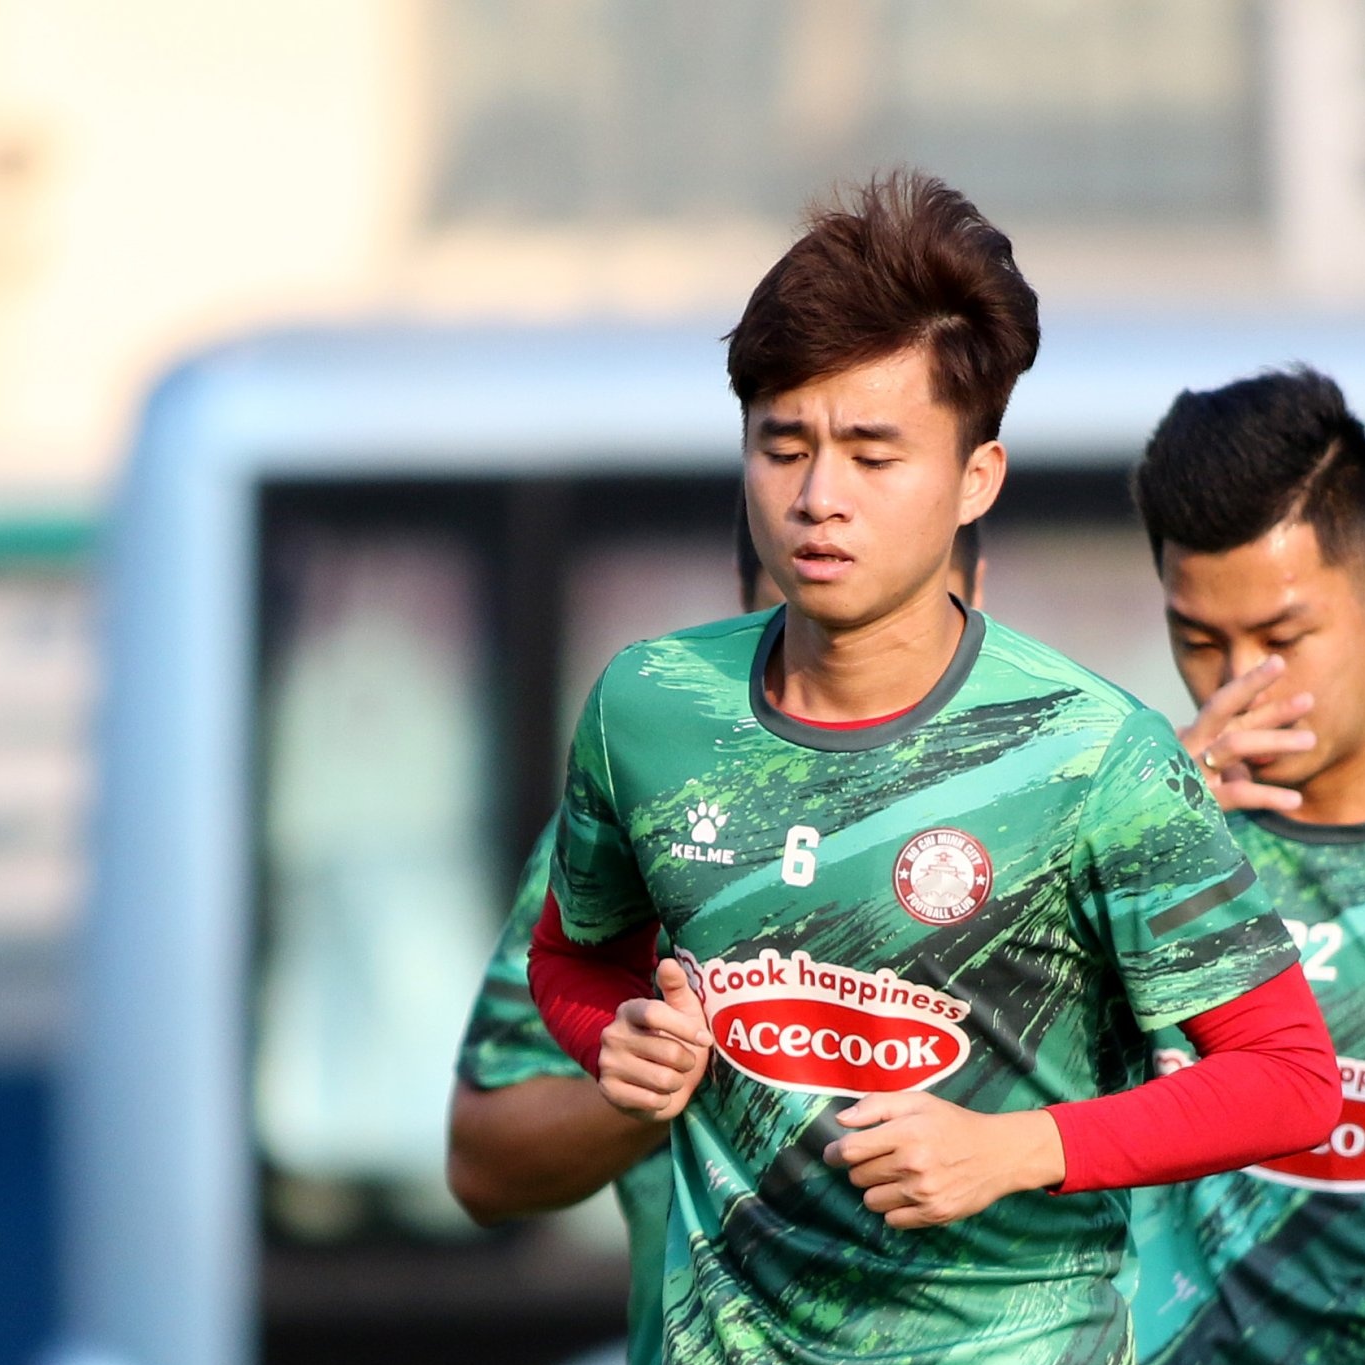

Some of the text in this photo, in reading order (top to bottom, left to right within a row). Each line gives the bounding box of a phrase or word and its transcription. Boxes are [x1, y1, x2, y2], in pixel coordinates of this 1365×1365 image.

[671, 843, 735, 865] KELME
[781, 825, 820, 887] 6
[904, 833, 983, 865] HO CHI MINH CITY
[906, 893, 976, 919] FOOTBALL CLUB
[709, 958, 962, 1020] Cook happiness
